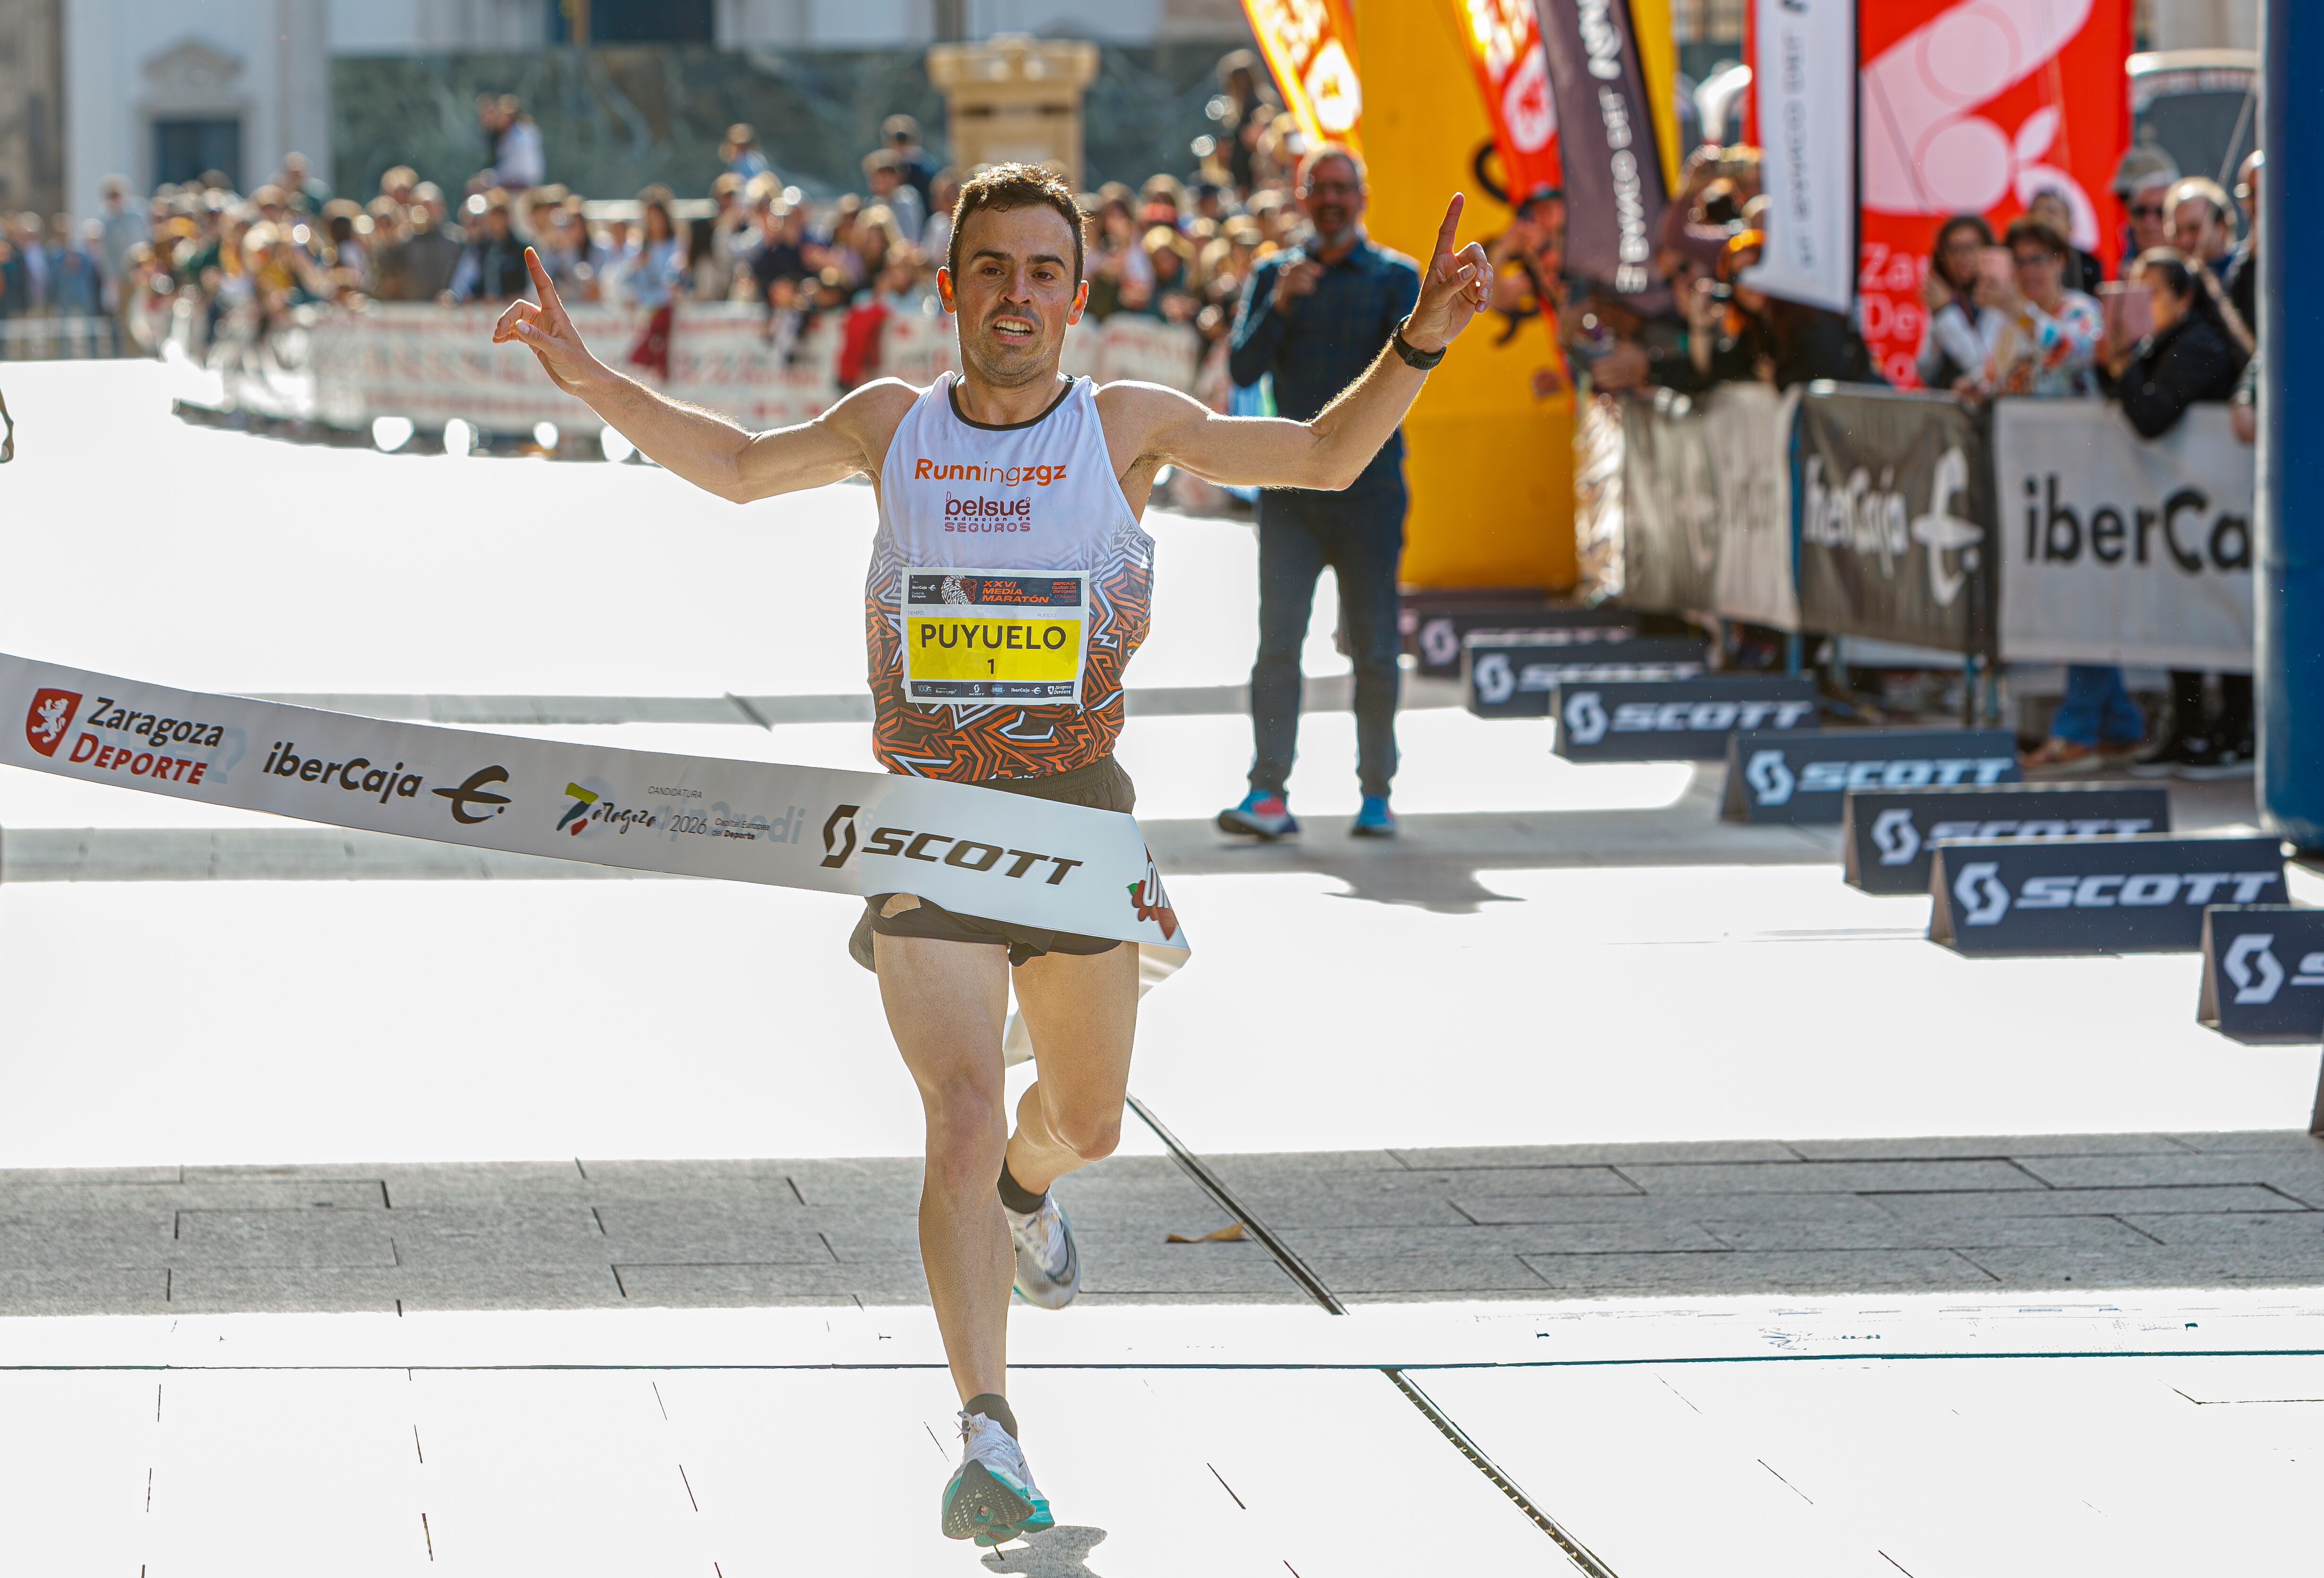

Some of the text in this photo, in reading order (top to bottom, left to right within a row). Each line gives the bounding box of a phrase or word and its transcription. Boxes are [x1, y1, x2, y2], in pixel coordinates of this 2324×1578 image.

[915, 458, 1067, 486] Runningzgz
[945, 522, 1031, 532] SEGUROS
[982, 594, 1049, 603] MARATÓN
[921, 624, 1066, 650] PUYUELO
[987, 659, 994, 674] 1
[87, 696, 225, 748] Zaragoza
[1610, 700, 1813, 732] SCOTT
[263, 741, 423, 804] iberCaja
[1797, 757, 2014, 792] SCOTT
[648, 785, 702, 799] CANDIDATURA
[669, 815, 708, 835] 2026
[714, 818, 771, 832] Capital Europea
[723, 829, 756, 840] Deporte
[862, 827, 1083, 885] SCOTT
[2014, 871, 2279, 909] SCOTT
